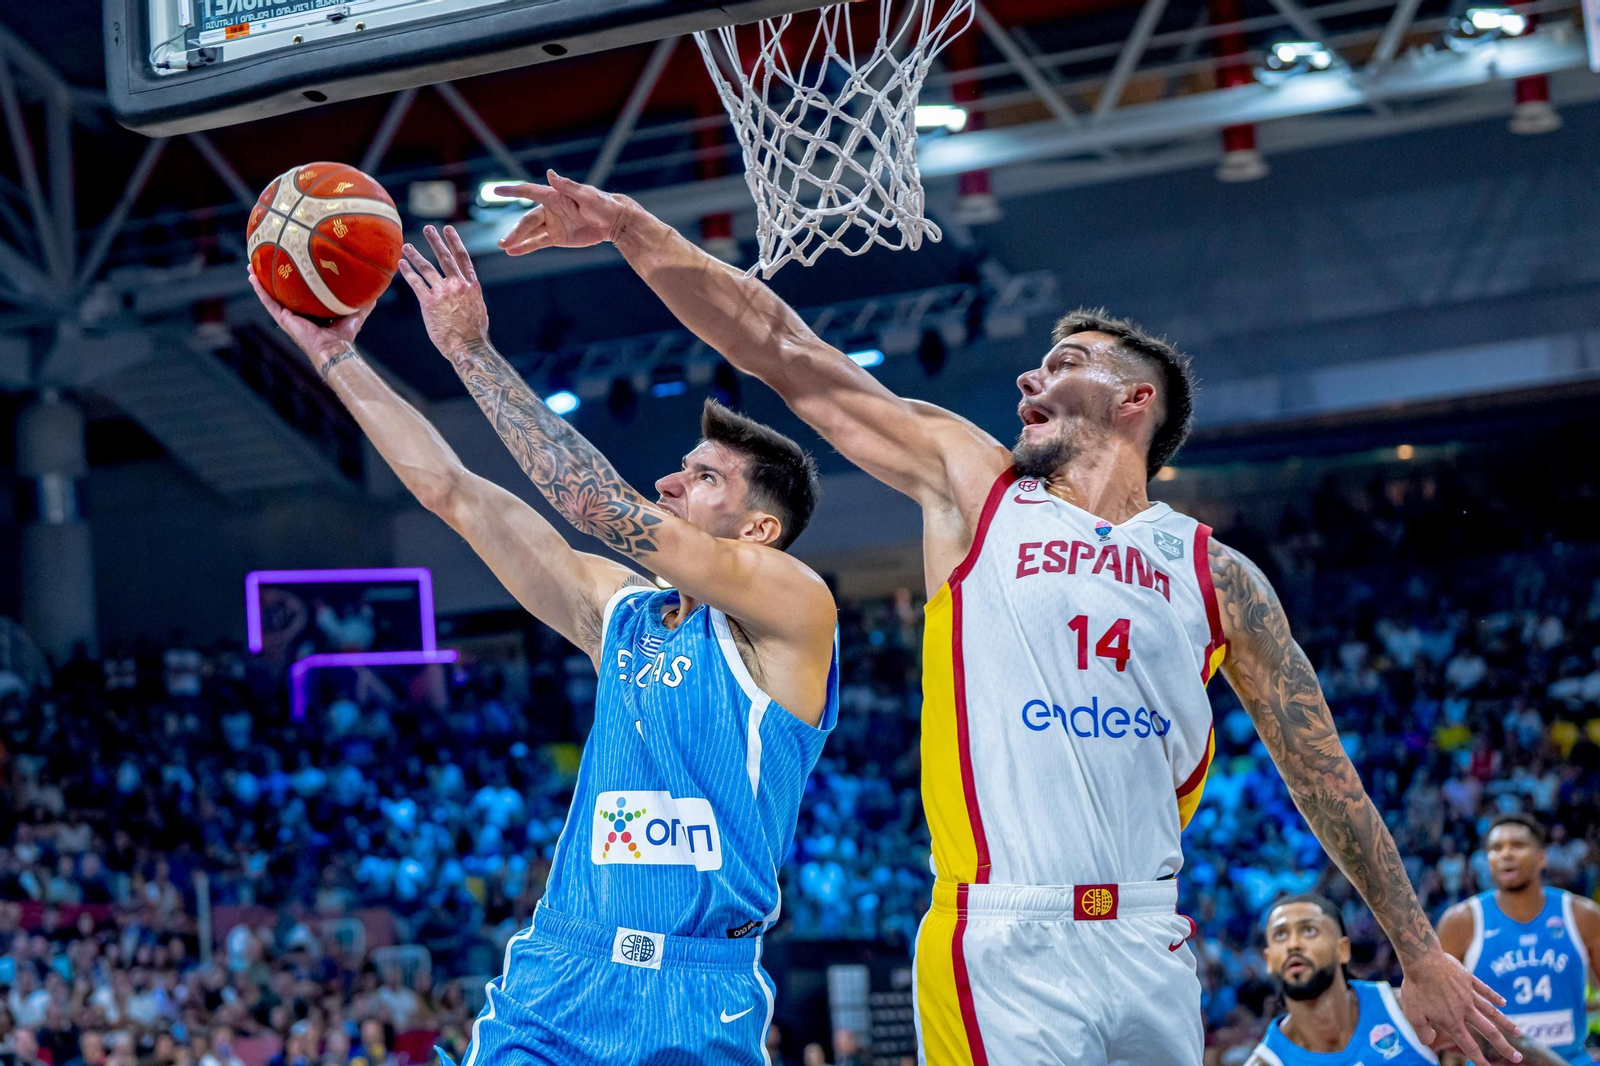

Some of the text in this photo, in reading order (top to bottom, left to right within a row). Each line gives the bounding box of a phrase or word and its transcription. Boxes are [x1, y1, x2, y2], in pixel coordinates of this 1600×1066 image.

[1067, 614, 1130, 672] 14
[1022, 696, 1171, 739] endesa
[633, 934, 642, 962] GRE
[1512, 974, 1553, 1005] 34
